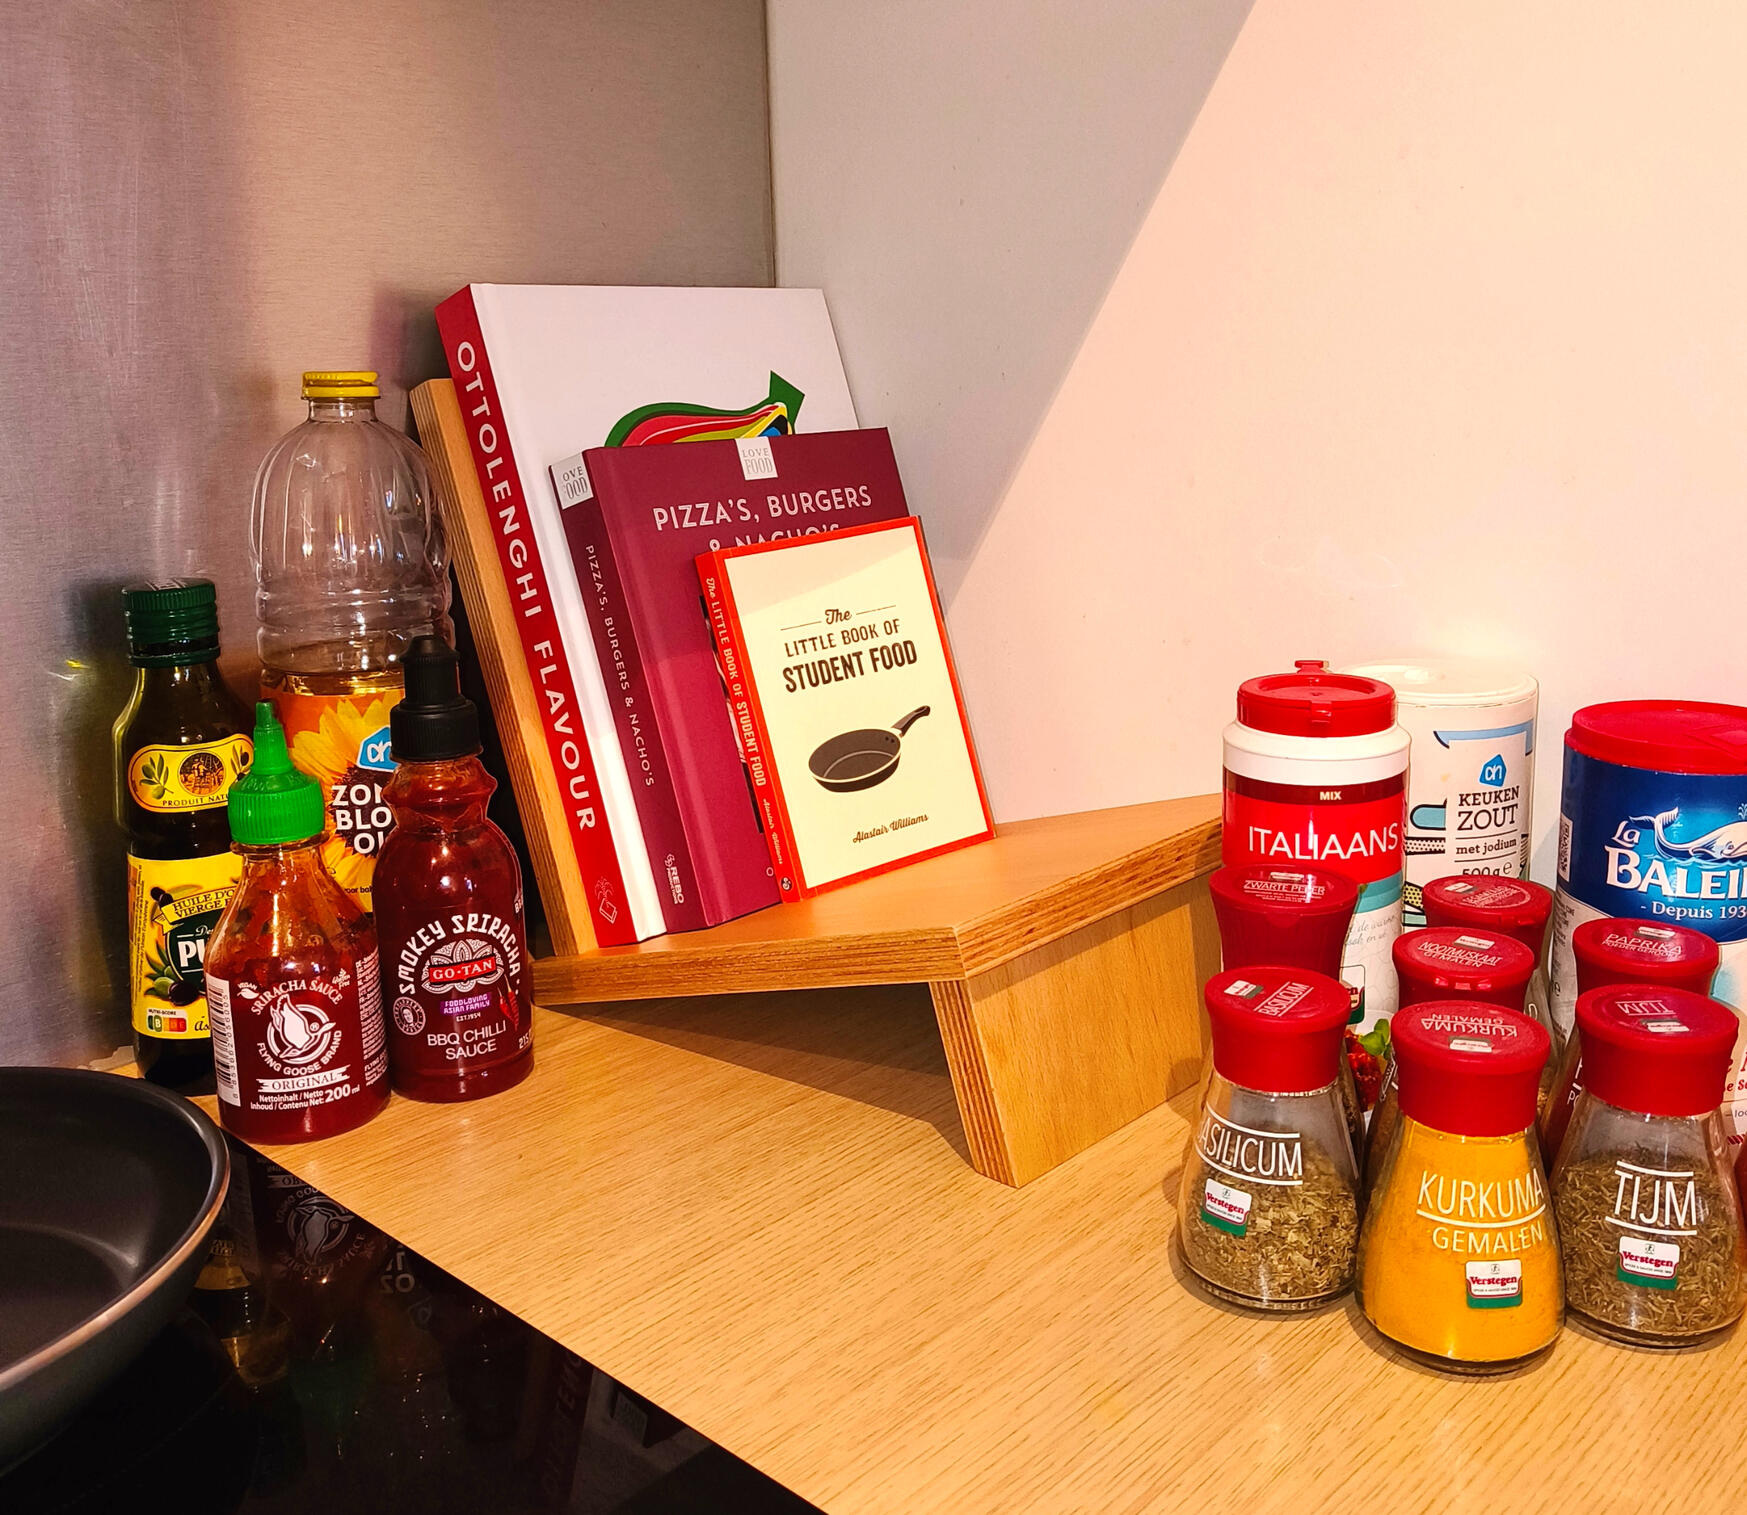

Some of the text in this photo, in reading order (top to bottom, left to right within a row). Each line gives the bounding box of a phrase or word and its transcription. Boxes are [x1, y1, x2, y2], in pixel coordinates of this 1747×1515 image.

[742, 447, 769, 458] LOVE
[744, 457, 774, 476] FOOD
[562, 477, 588, 500] OOD
[653, 485, 872, 531] PIZZA'S, BURGERS
[457, 341, 596, 831] OTTOLENGHI FLAVOUR
[706, 577, 716, 599] The
[711, 601, 730, 645] LITTLE
[825, 608, 852, 625] The
[784, 618, 901, 658] LITTLE BOOK OF
[586, 545, 654, 786] PIZZA'S, BURGERS & NACHO'S
[723, 648, 739, 680] BOOK
[782, 640, 918, 693] STUDENT FOOD
[732, 683, 743, 697] OF
[736, 701, 759, 758] STUDENT
[750, 756, 767, 787] FOOD
[162, 797, 204, 806] PRODUIT
[1319, 791, 1342, 800] MIX
[1458, 785, 1520, 807] KEUKEN
[1457, 803, 1519, 831] ZOUT
[852, 813, 929, 844] Alastair Williams
[1611, 820, 1641, 848] La
[1248, 823, 1398, 860] ITALIAANS
[1456, 838, 1517, 855] met jodium
[670, 866, 684, 904] REBO
[1243, 880, 1289, 892] ZWARTE
[173, 893, 212, 911] HUILE
[175, 900, 223, 918] VIERGE
[1652, 901, 1747, 920] Depuis 193
[398, 913, 521, 995] SMOKEY SRIRACHA
[1417, 941, 1503, 966] NOOTMUSKAAT
[1602, 941, 1636, 952] POEDER
[1605, 933, 1682, 955] PAPRIKA
[1424, 951, 1484, 967] GEMALEN
[237, 982, 258, 990] VEGAN
[251, 979, 343, 1015] SRIRACHA SAUCE
[443, 1000, 490, 1014] ASIAN FAMILY
[1258, 982, 1310, 1016] BASILICUM
[1421, 1019, 1518, 1038] KURKUMA
[1432, 1013, 1504, 1025] GEMALEN
[427, 1020, 506, 1047] BBQ CHILLI
[257, 1030, 342, 1076] FLYING GOOSE BRAND
[445, 1039, 497, 1060] SAUCE
[272, 1073, 337, 1090] ORIGINAL
[259, 1093, 298, 1103] Nettoinhalt
[304, 1090, 324, 1100] Netto
[325, 1084, 361, 1103] 200 ml
[250, 1102, 273, 1110] Inhoud
[278, 1100, 308, 1110] Contenu
[1199, 1116, 1303, 1176] ASILICUM
[1206, 1192, 1244, 1215] Verstegen
[1418, 1168, 1545, 1218] KURKUMA
[1614, 1169, 1697, 1227] TIJM
[1432, 1220, 1543, 1254] GEMALEN
[1622, 1251, 1673, 1267] Verstegen
[1469, 1276, 1517, 1286] Verstegen
